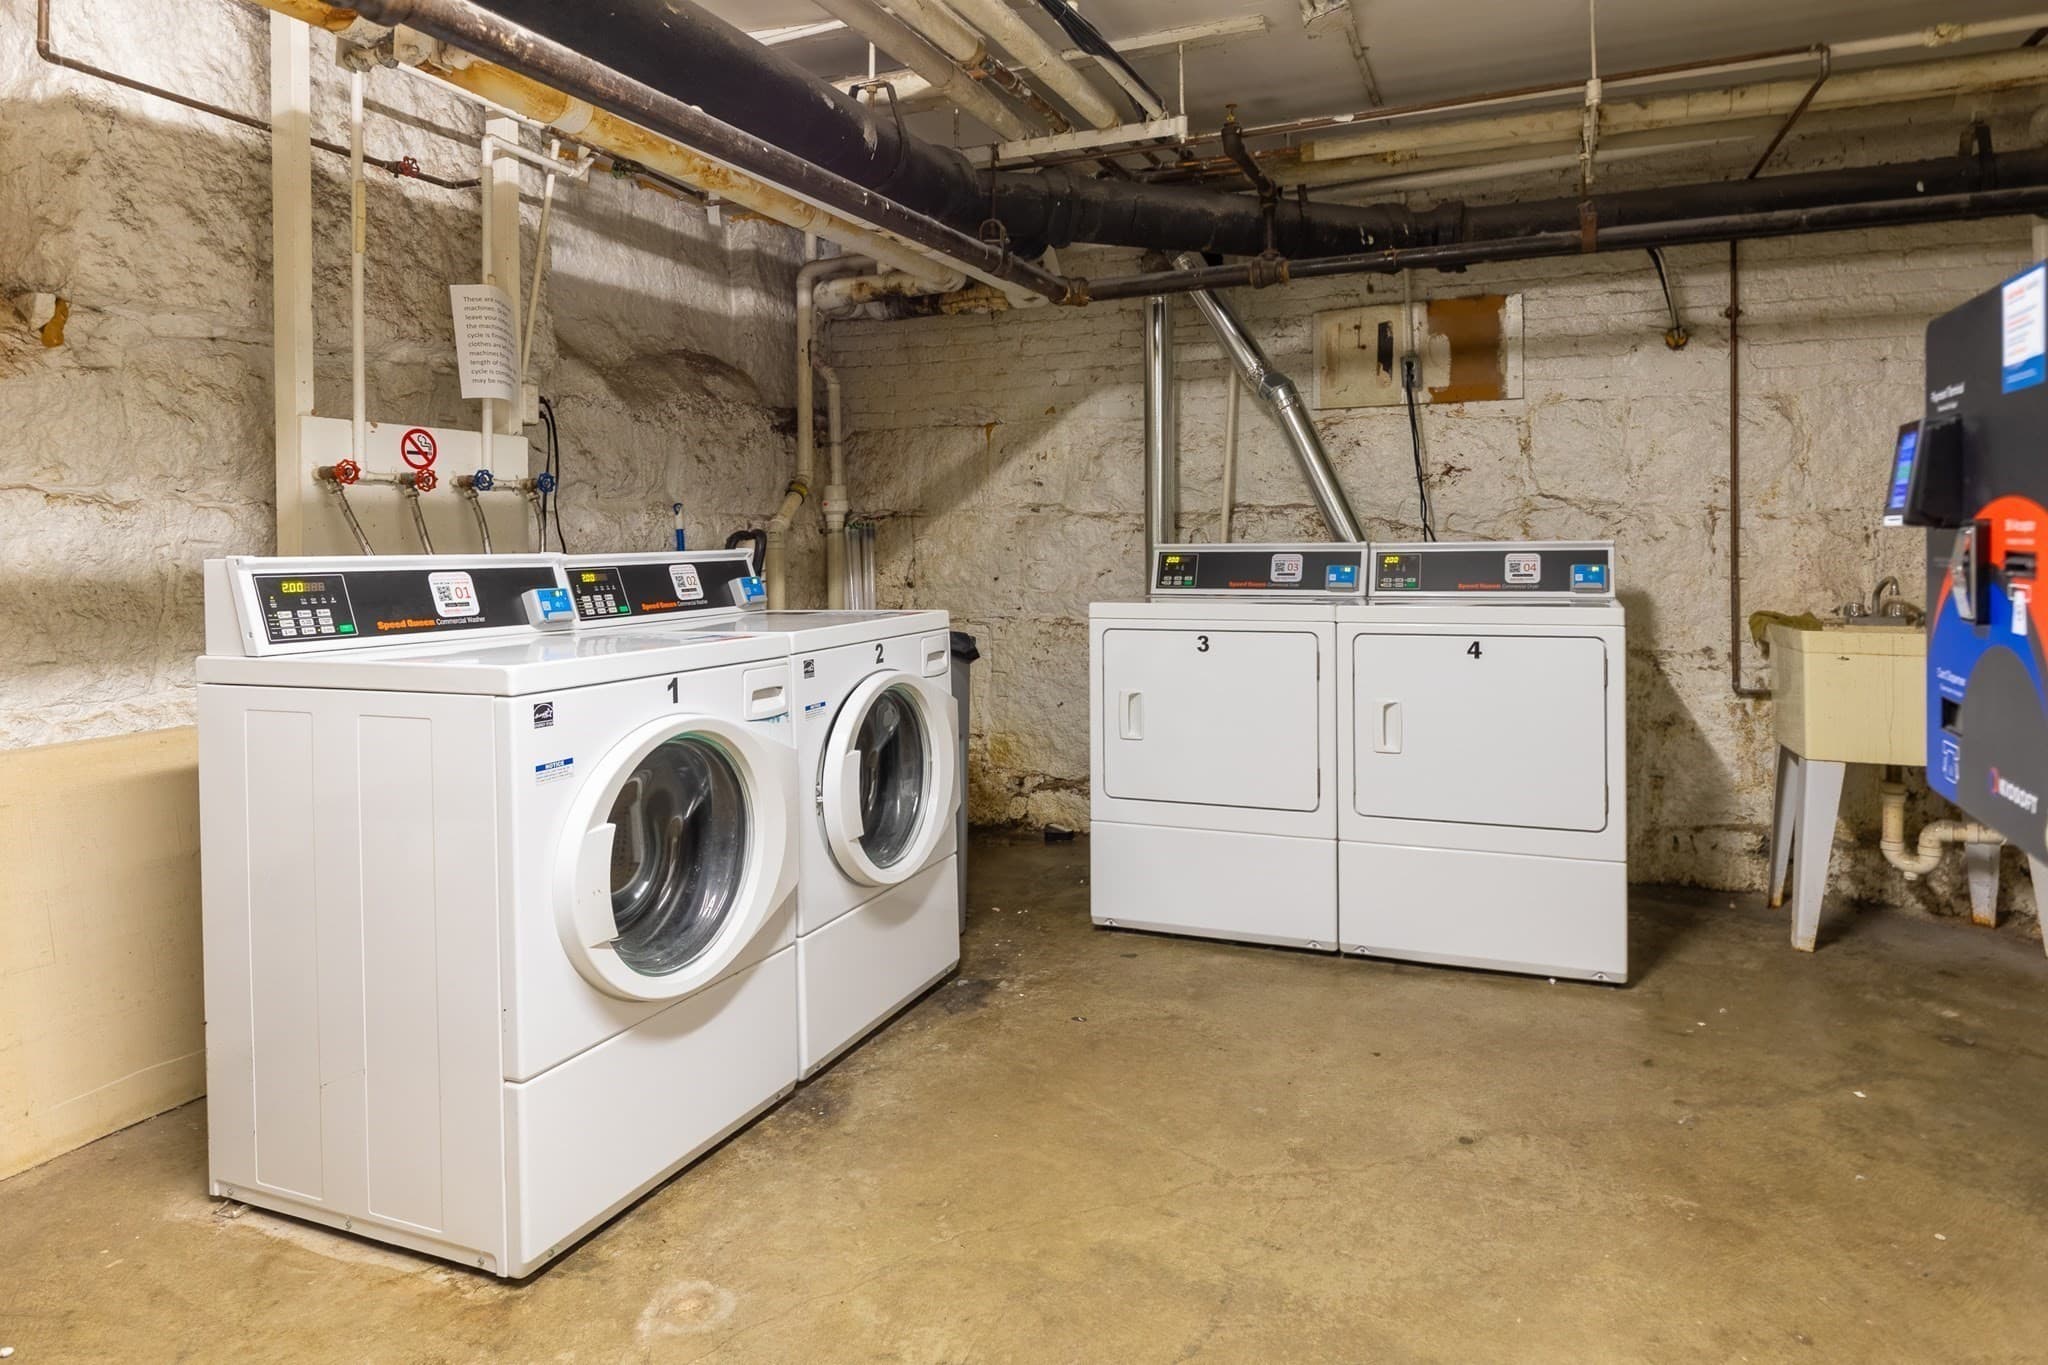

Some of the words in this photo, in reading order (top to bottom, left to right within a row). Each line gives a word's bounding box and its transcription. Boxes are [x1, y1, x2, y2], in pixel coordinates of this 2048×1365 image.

[1287, 563, 1299, 572] 03
[1523, 563, 1537, 572] 04
[687, 576, 697, 586] 02
[455, 586, 472, 599] 01
[377, 620, 407, 631] Speed
[1197, 635, 1209, 652] 3
[1467, 641, 1482, 659] 4
[875, 643, 884, 664] 2
[667, 677, 679, 704] 1
